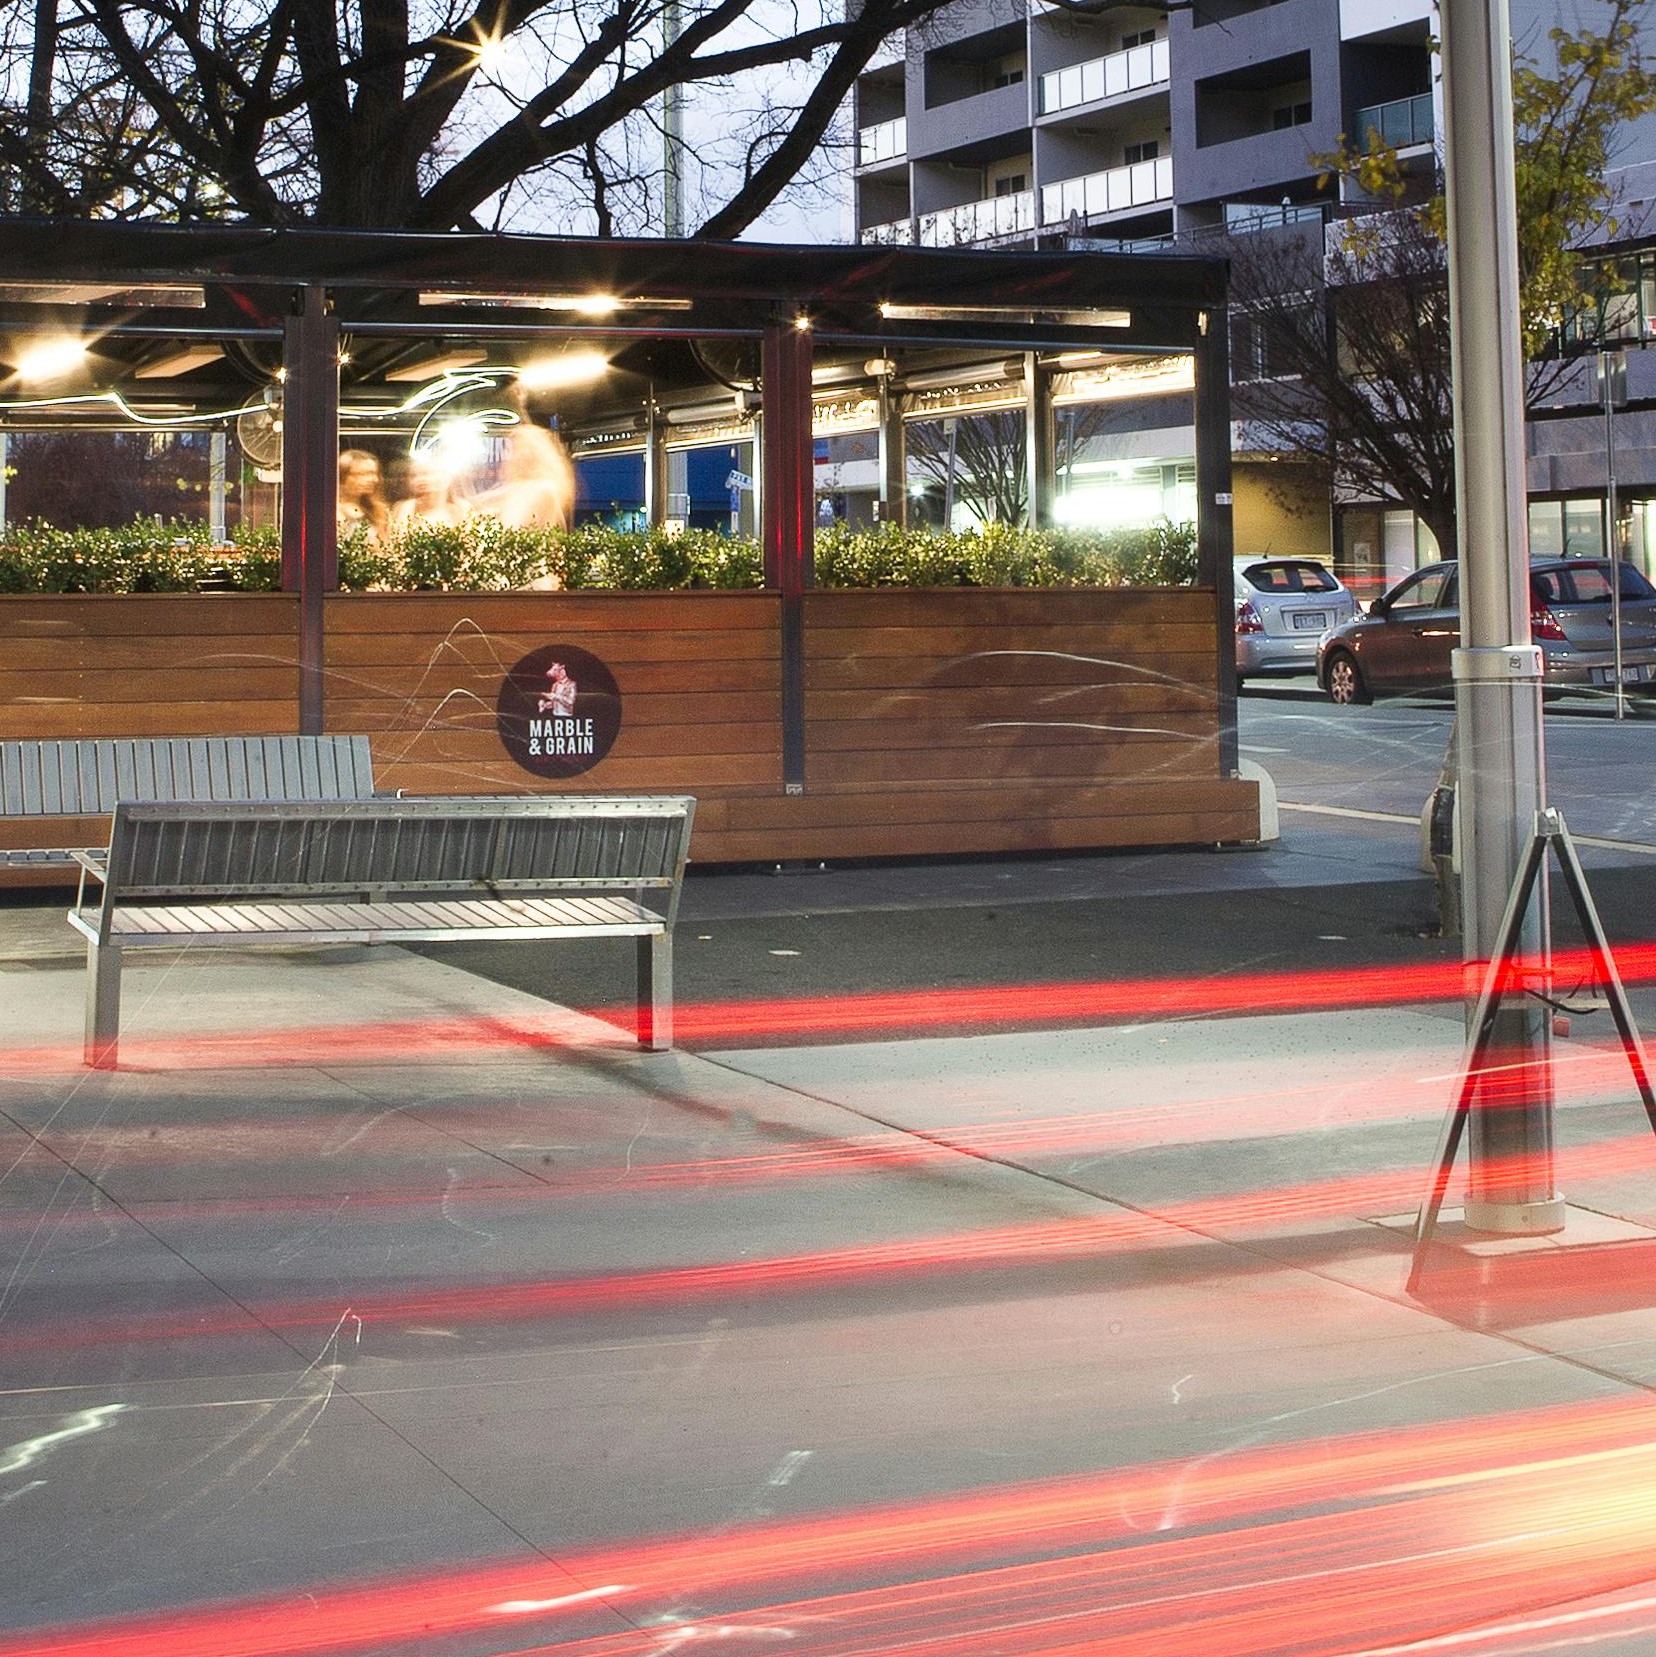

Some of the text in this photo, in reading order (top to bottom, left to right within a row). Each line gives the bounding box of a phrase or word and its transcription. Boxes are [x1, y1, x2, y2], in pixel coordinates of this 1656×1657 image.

[529, 718, 594, 738] MARBLE
[528, 736, 594, 755] & GRAIN
